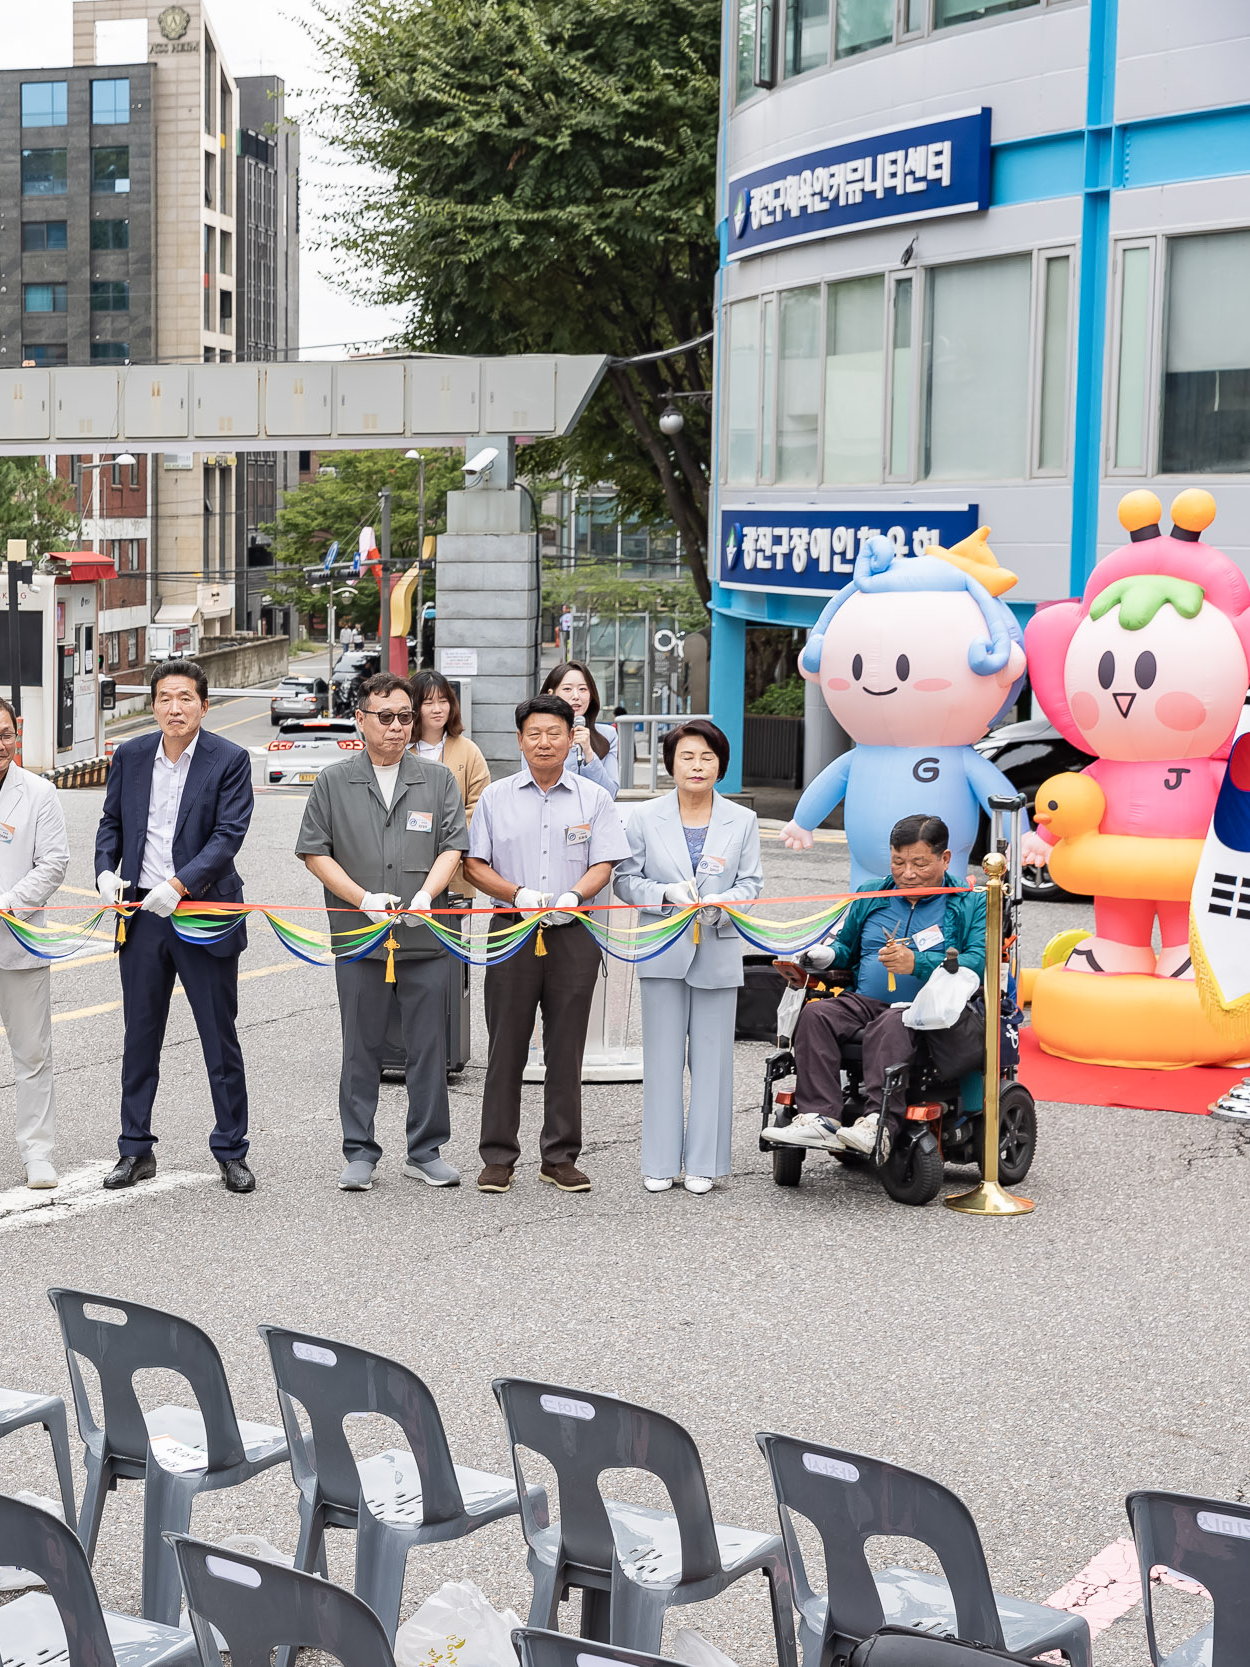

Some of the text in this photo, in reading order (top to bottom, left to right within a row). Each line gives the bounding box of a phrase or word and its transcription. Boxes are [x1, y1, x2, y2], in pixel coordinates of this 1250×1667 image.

[750, 141, 952, 230] 광진구체육인커뮤니티센터
[913, 757, 940, 783] G
[1164, 768, 1190, 790] J
